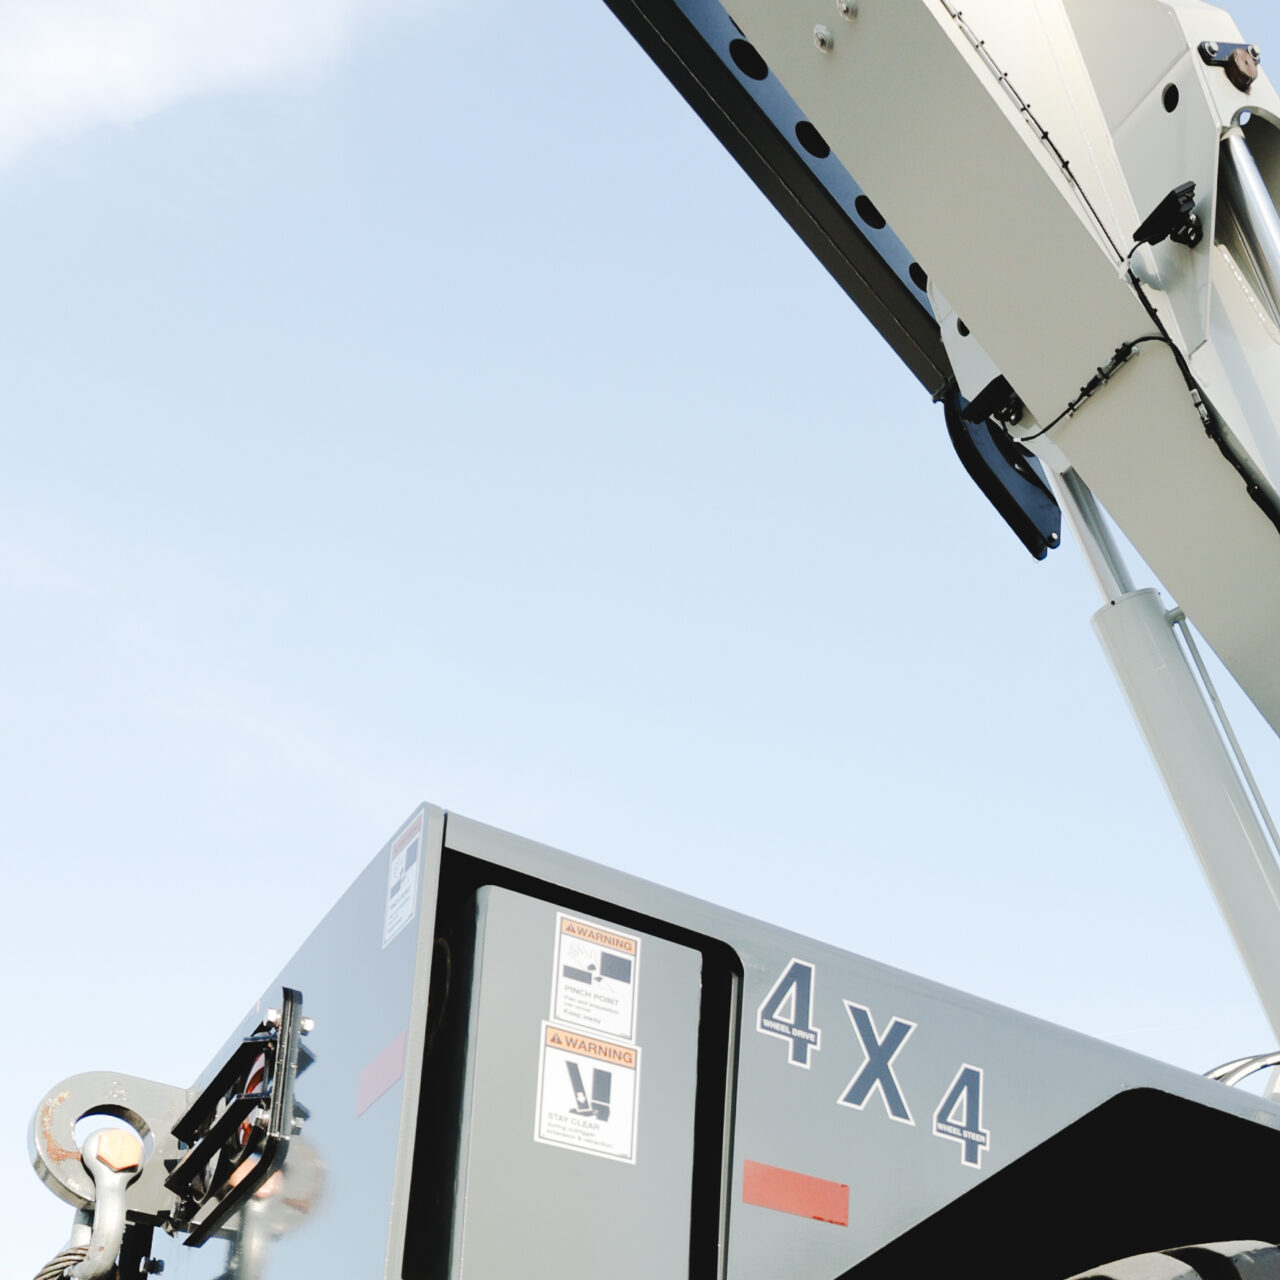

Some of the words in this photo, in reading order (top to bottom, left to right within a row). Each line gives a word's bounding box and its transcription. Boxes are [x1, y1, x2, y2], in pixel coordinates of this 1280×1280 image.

[577, 925, 632, 951] WARNING
[564, 985, 592, 999] PINCH
[593, 991, 619, 1006] POINT
[762, 1019, 791, 1035] WHEEL
[792, 1027, 816, 1042] DRIVE
[565, 1035, 632, 1064] WARNING
[756, 957, 821, 1069] 4
[836, 999, 918, 1127] X
[932, 1063, 990, 1170] 4
[548, 1112, 568, 1123] STAY
[571, 1117, 600, 1130] CLEAR
[936, 1122, 962, 1137] WHEEL
[963, 1129, 986, 1144] STEER
